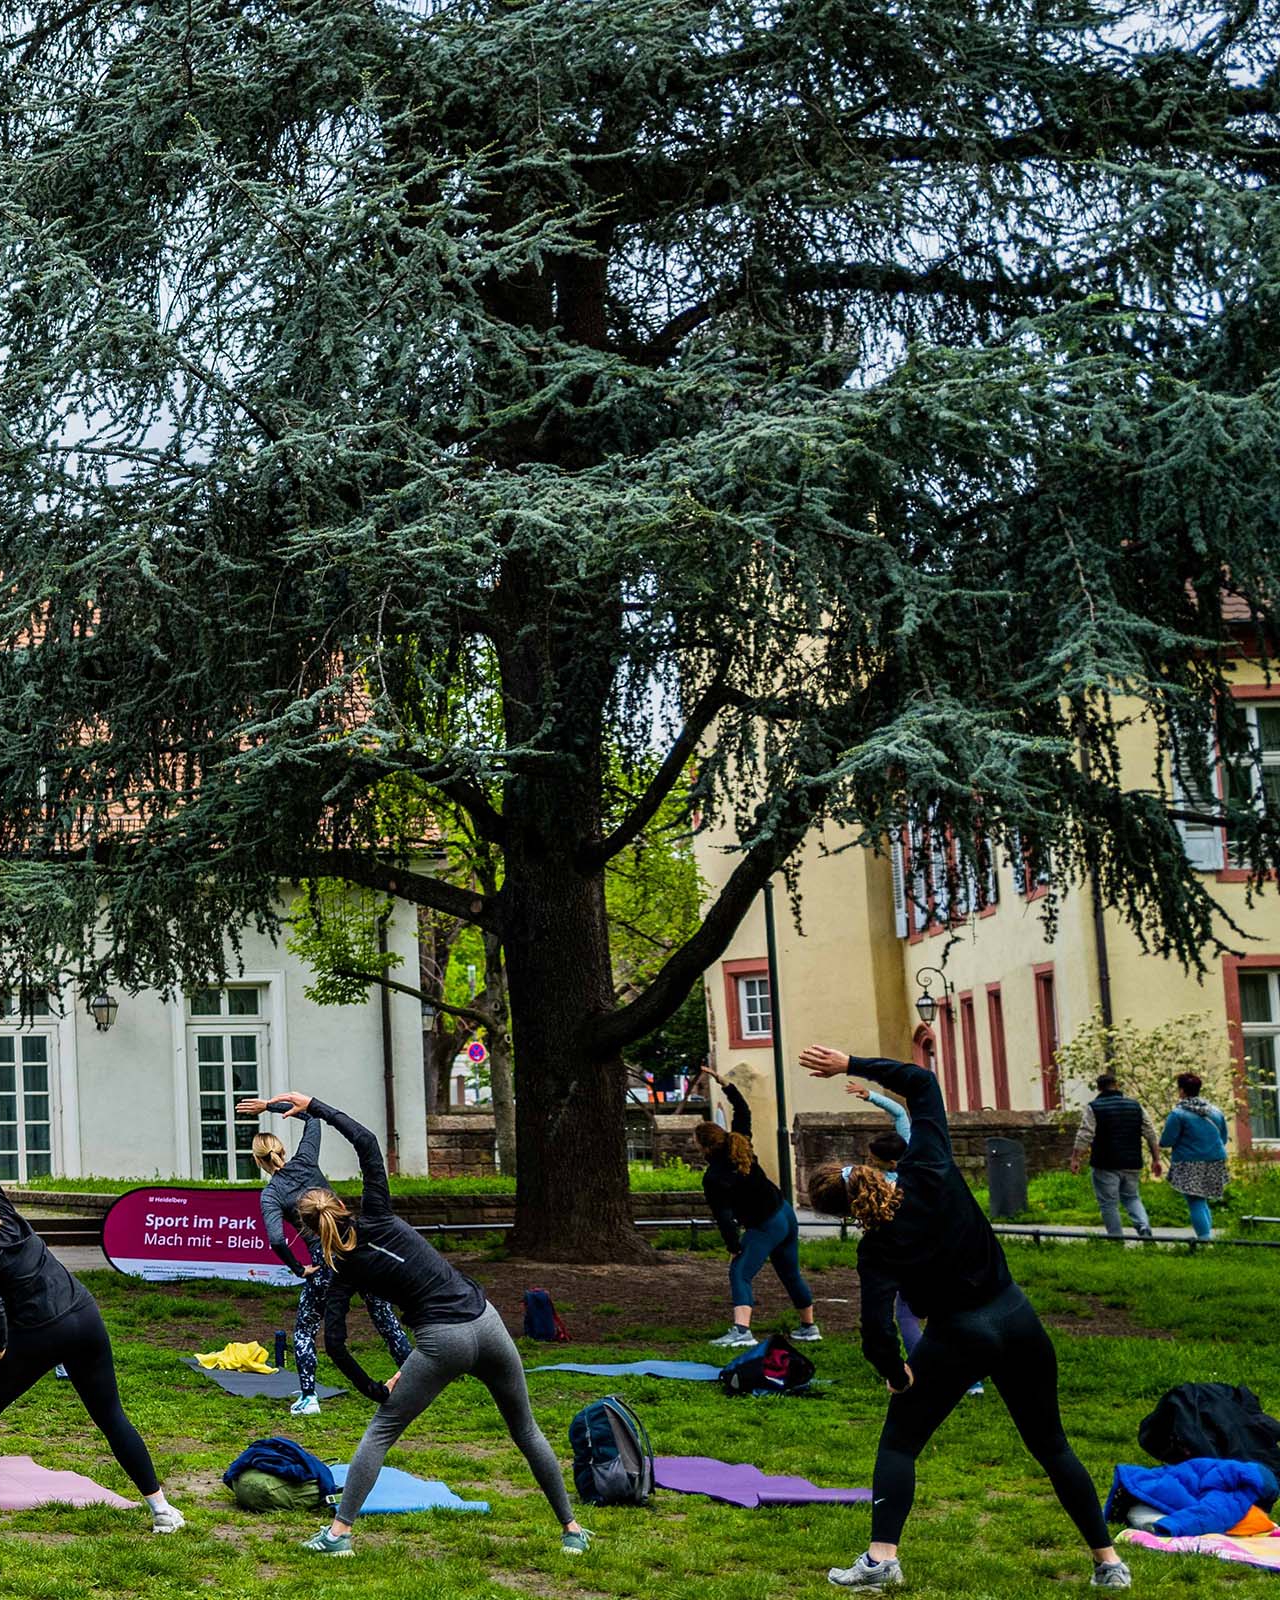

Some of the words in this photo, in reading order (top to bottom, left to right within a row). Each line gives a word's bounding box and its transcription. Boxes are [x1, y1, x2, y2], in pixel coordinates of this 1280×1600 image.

[154, 1196, 188, 1205] Heidelberg
[145, 1213, 189, 1230] Sport
[193, 1214, 214, 1229] im
[218, 1215, 256, 1230] Park
[144, 1232, 183, 1247] Mach
[187, 1234, 212, 1247] mit
[227, 1235, 264, 1249] Bleib
